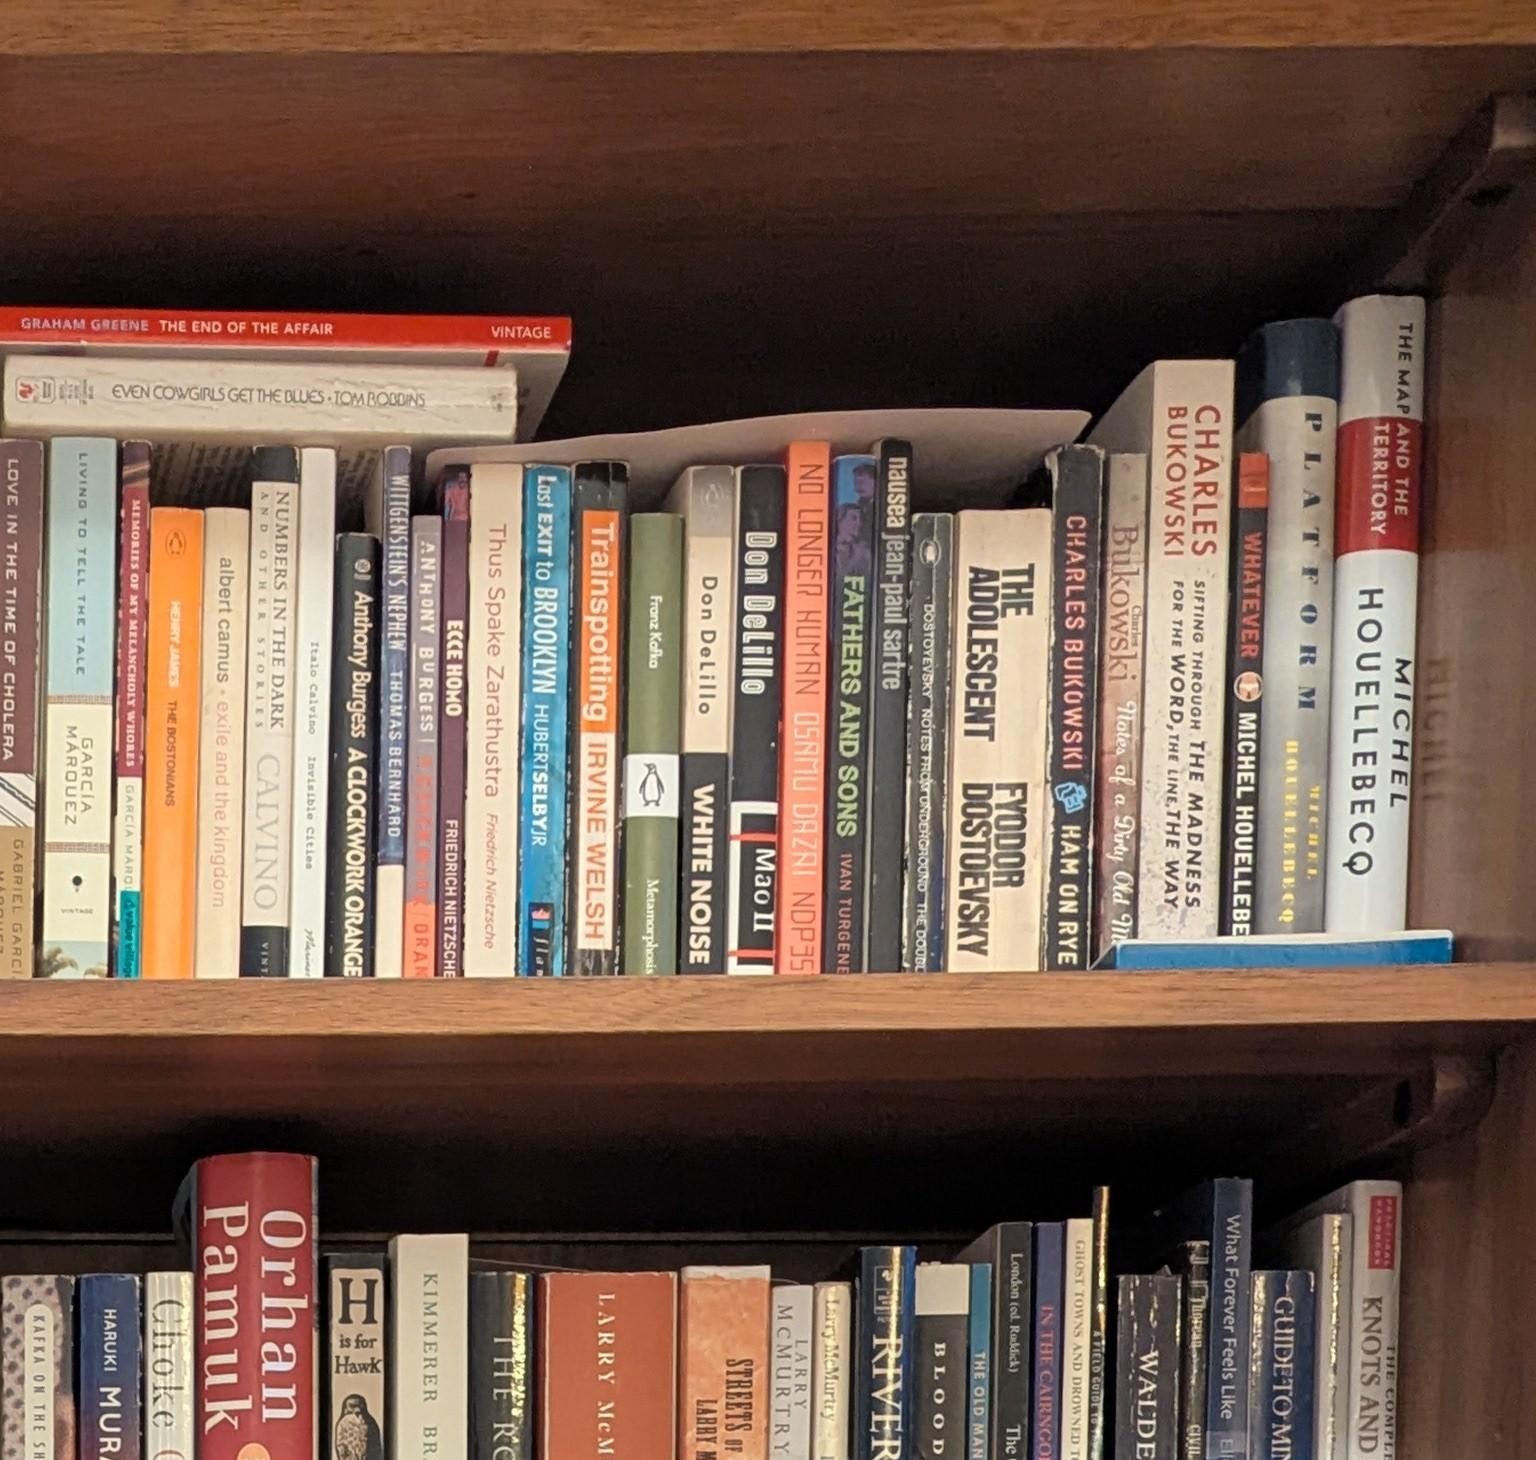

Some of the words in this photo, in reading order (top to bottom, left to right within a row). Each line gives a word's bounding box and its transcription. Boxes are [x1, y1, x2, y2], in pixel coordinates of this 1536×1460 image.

[20, 317, 86, 331] GRAHAM
[90, 318, 149, 332] GREENE
[158, 319, 186, 334] THE
[190, 320, 222, 335] END
[226, 321, 246, 335] OF
[250, 321, 277, 335] THE
[281, 322, 333, 336] AFFAIR
[490, 325, 551, 340] VINTAGE
[1398, 322, 1413, 363] THE
[1398, 368, 1412, 415] MAP
[1165, 405, 1188, 557] BUKOWSKI
[1192, 404, 1221, 557] CHARLES
[1370, 422, 1391, 536] TERRITORY
[1396, 423, 1412, 470] AND
[1394, 477, 1410, 516] THE
[581, 523, 617, 723] Trainspotting
[1001, 563, 1034, 617] THE
[963, 565, 1000, 742] ADOLESCENT
[1341, 588, 1384, 876] HOUELLEBECQ
[1389, 658, 1412, 808] MICHEL
[584, 741, 607, 834] IRVINE
[689, 783, 715, 873] WHITE
[957, 782, 993, 957] DOSTOEVSKY
[992, 782, 1028, 889] FYODOR
[584, 842, 606, 940] WELSH
[688, 880, 711, 965] NOISE
[103, 1308, 118, 1373] HARUKI
[202, 1203, 253, 1432] Pamuk
[258, 1209, 309, 1423] Orhan
[338, 1276, 378, 1326] H
[339, 1333, 353, 1350] is
[356, 1333, 378, 1350] for
[1358, 1295, 1383, 1389] KNOTS
[334, 1355, 382, 1375] Hawk
[725, 1359, 754, 1432] STREETS
[725, 1439, 744, 1454] OF
[1357, 1396, 1381, 1449] AND
